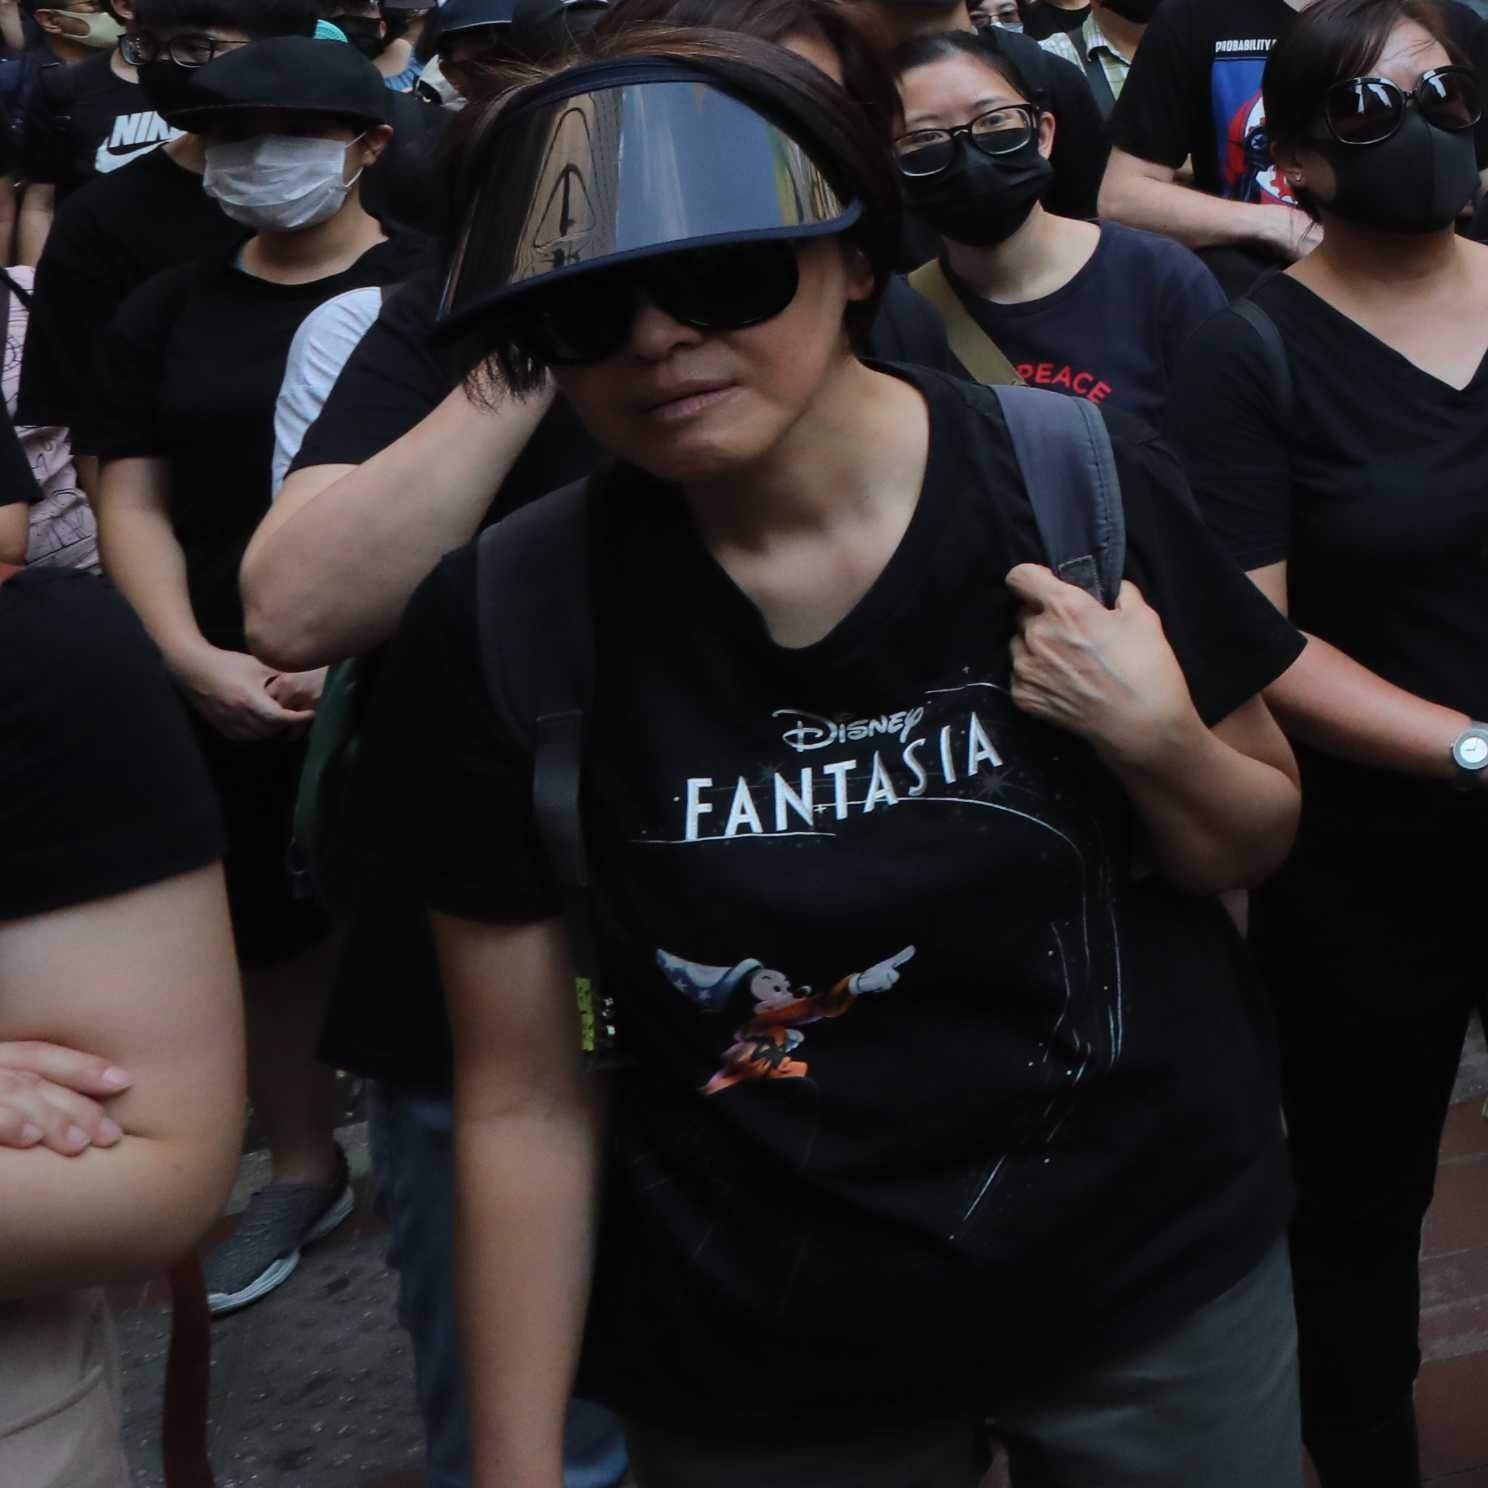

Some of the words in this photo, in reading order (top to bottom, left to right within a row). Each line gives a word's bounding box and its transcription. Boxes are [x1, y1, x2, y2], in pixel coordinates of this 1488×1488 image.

[1215, 39, 1271, 52] PROBABILITY
[109, 111, 187, 148] NIK
[1017, 361, 1112, 404] PEACE
[686, 712, 1003, 841] FANTASIA
